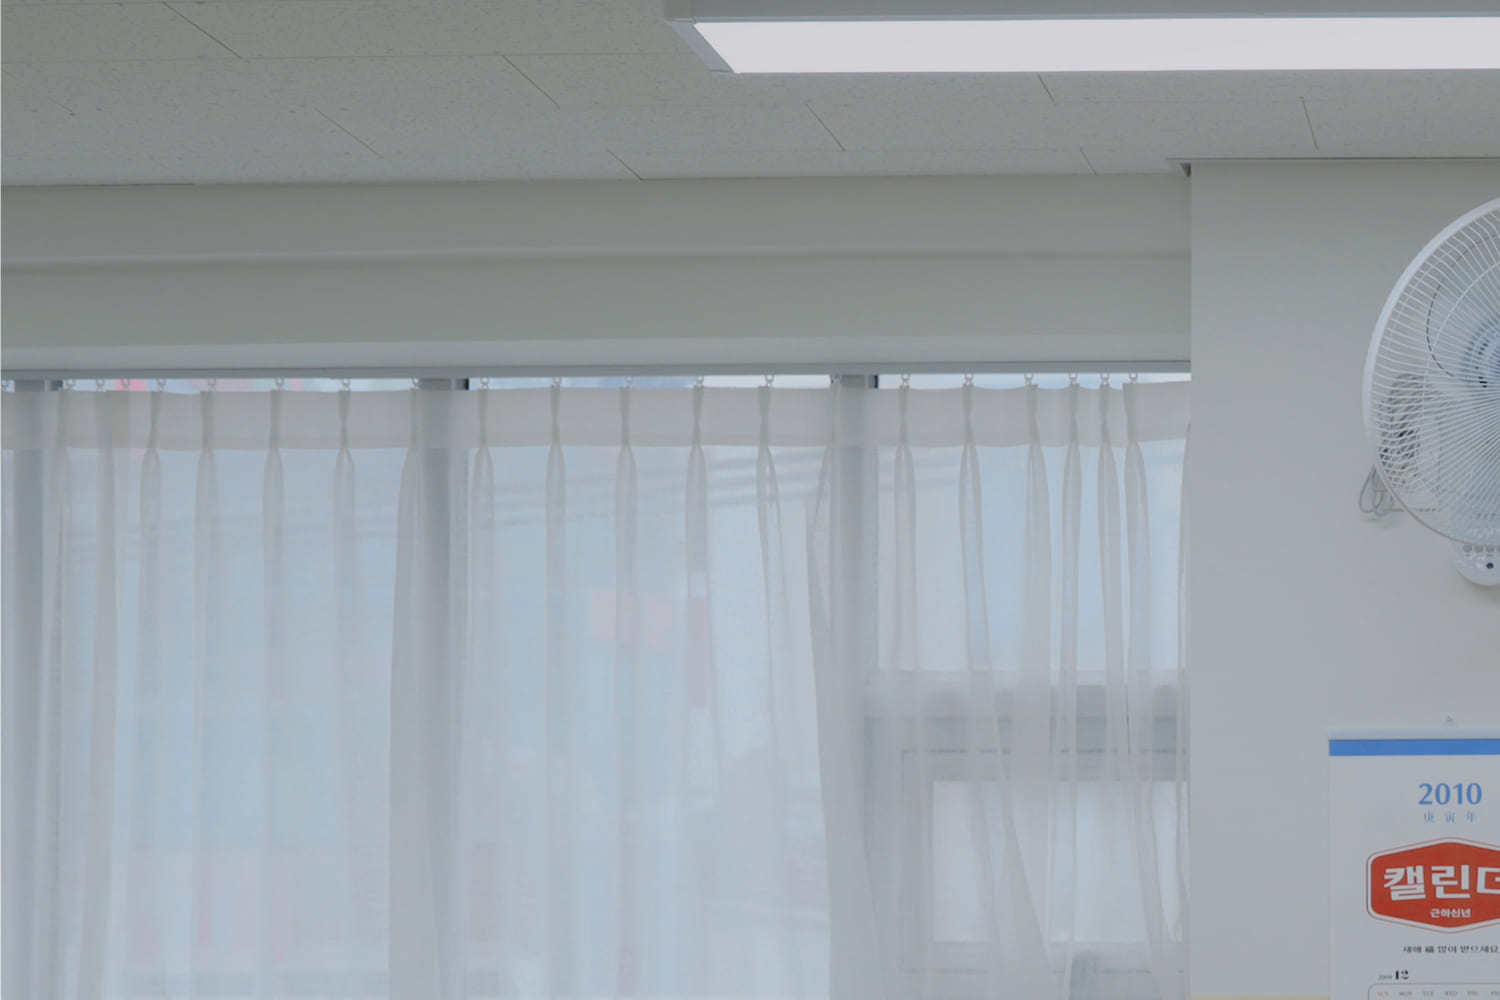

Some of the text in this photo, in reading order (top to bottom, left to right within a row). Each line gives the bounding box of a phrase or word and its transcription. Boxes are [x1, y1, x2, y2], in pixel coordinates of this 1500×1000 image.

[1418, 782, 1482, 805] 2010
[1430, 908, 1471, 919] 근하신년
[1395, 969, 1410, 980] 12
